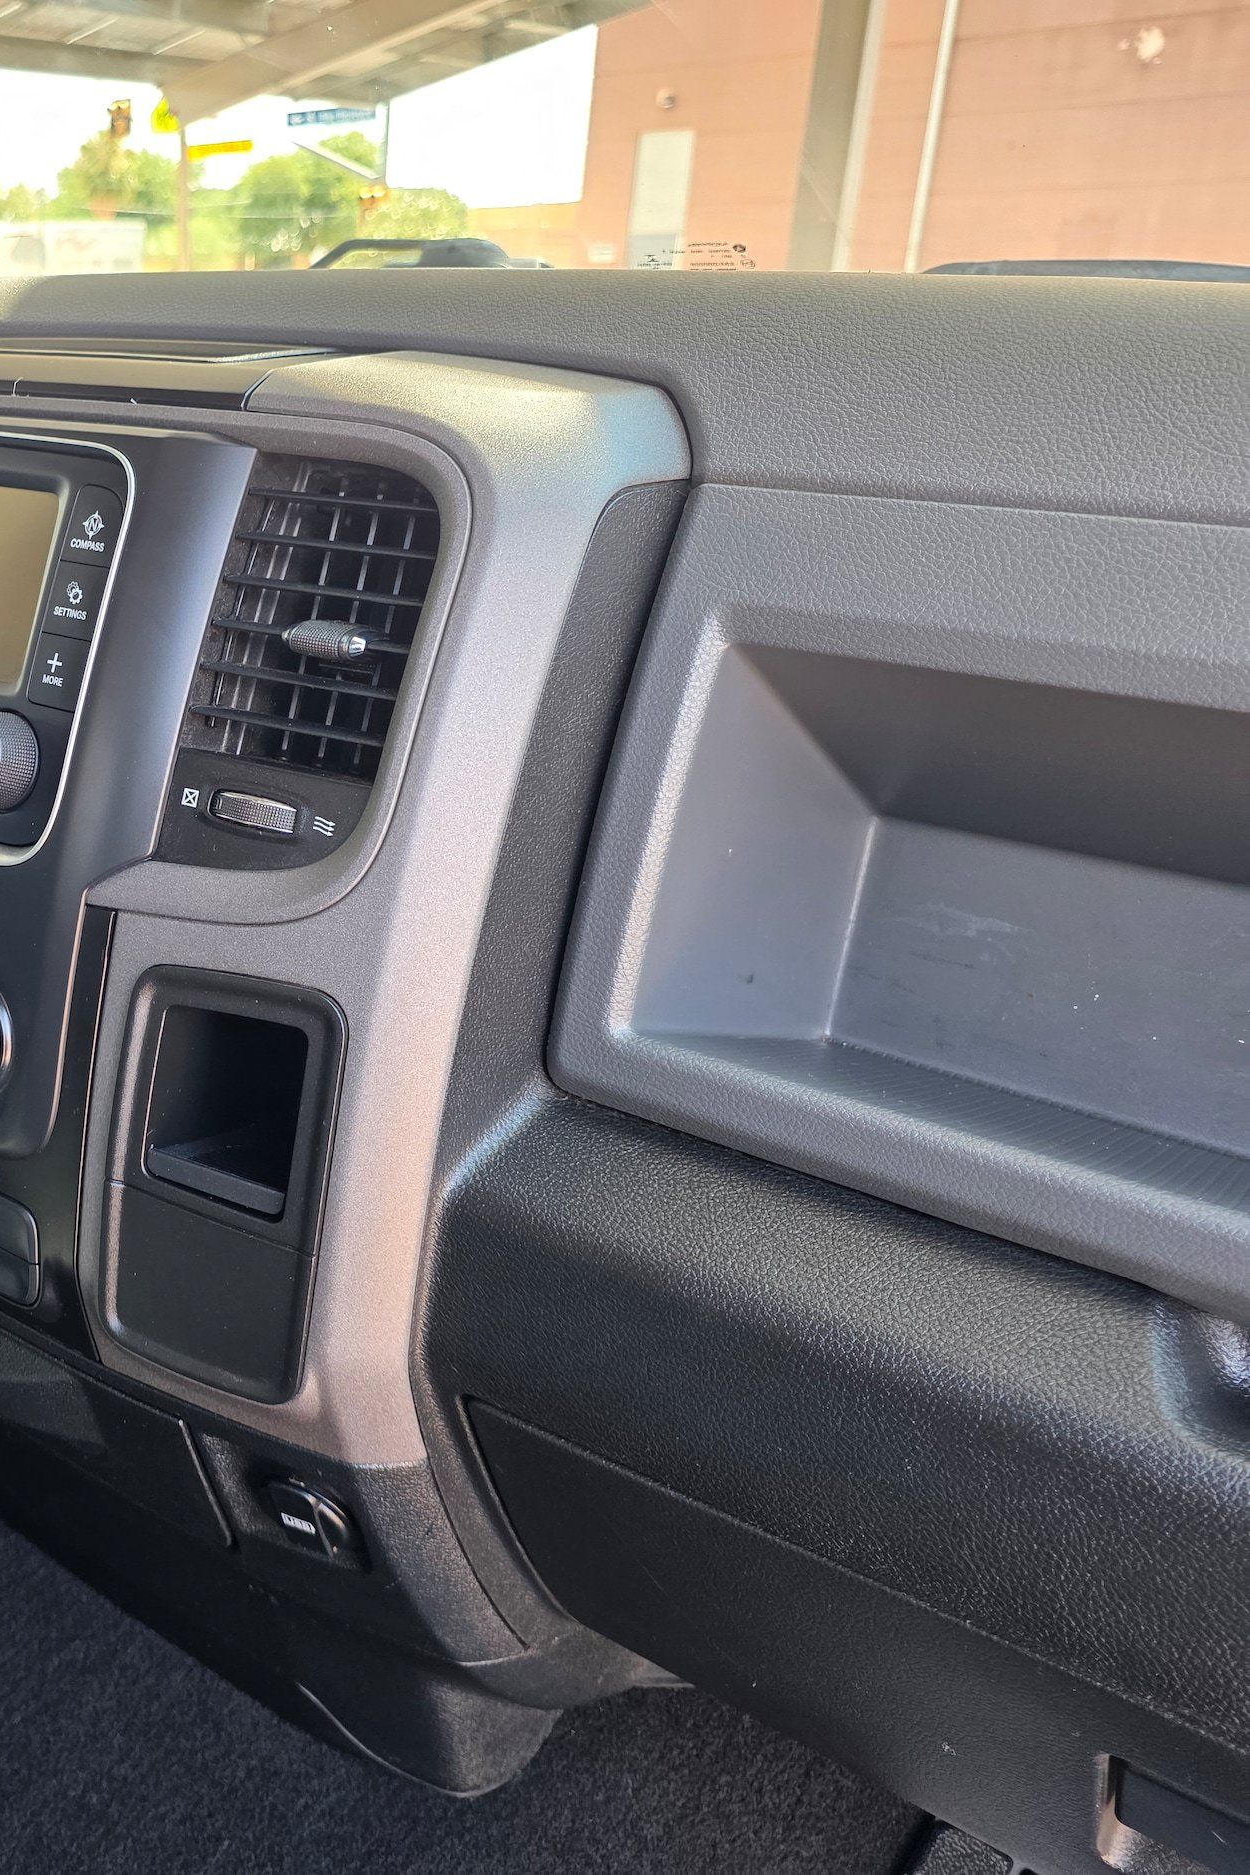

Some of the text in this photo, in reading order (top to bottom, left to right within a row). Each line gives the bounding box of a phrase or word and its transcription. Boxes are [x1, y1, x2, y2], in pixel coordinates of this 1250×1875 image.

[70, 537, 105, 553] COMPASS
[53, 605, 88, 621] SETTINGS
[42, 674, 64, 687] MORE
